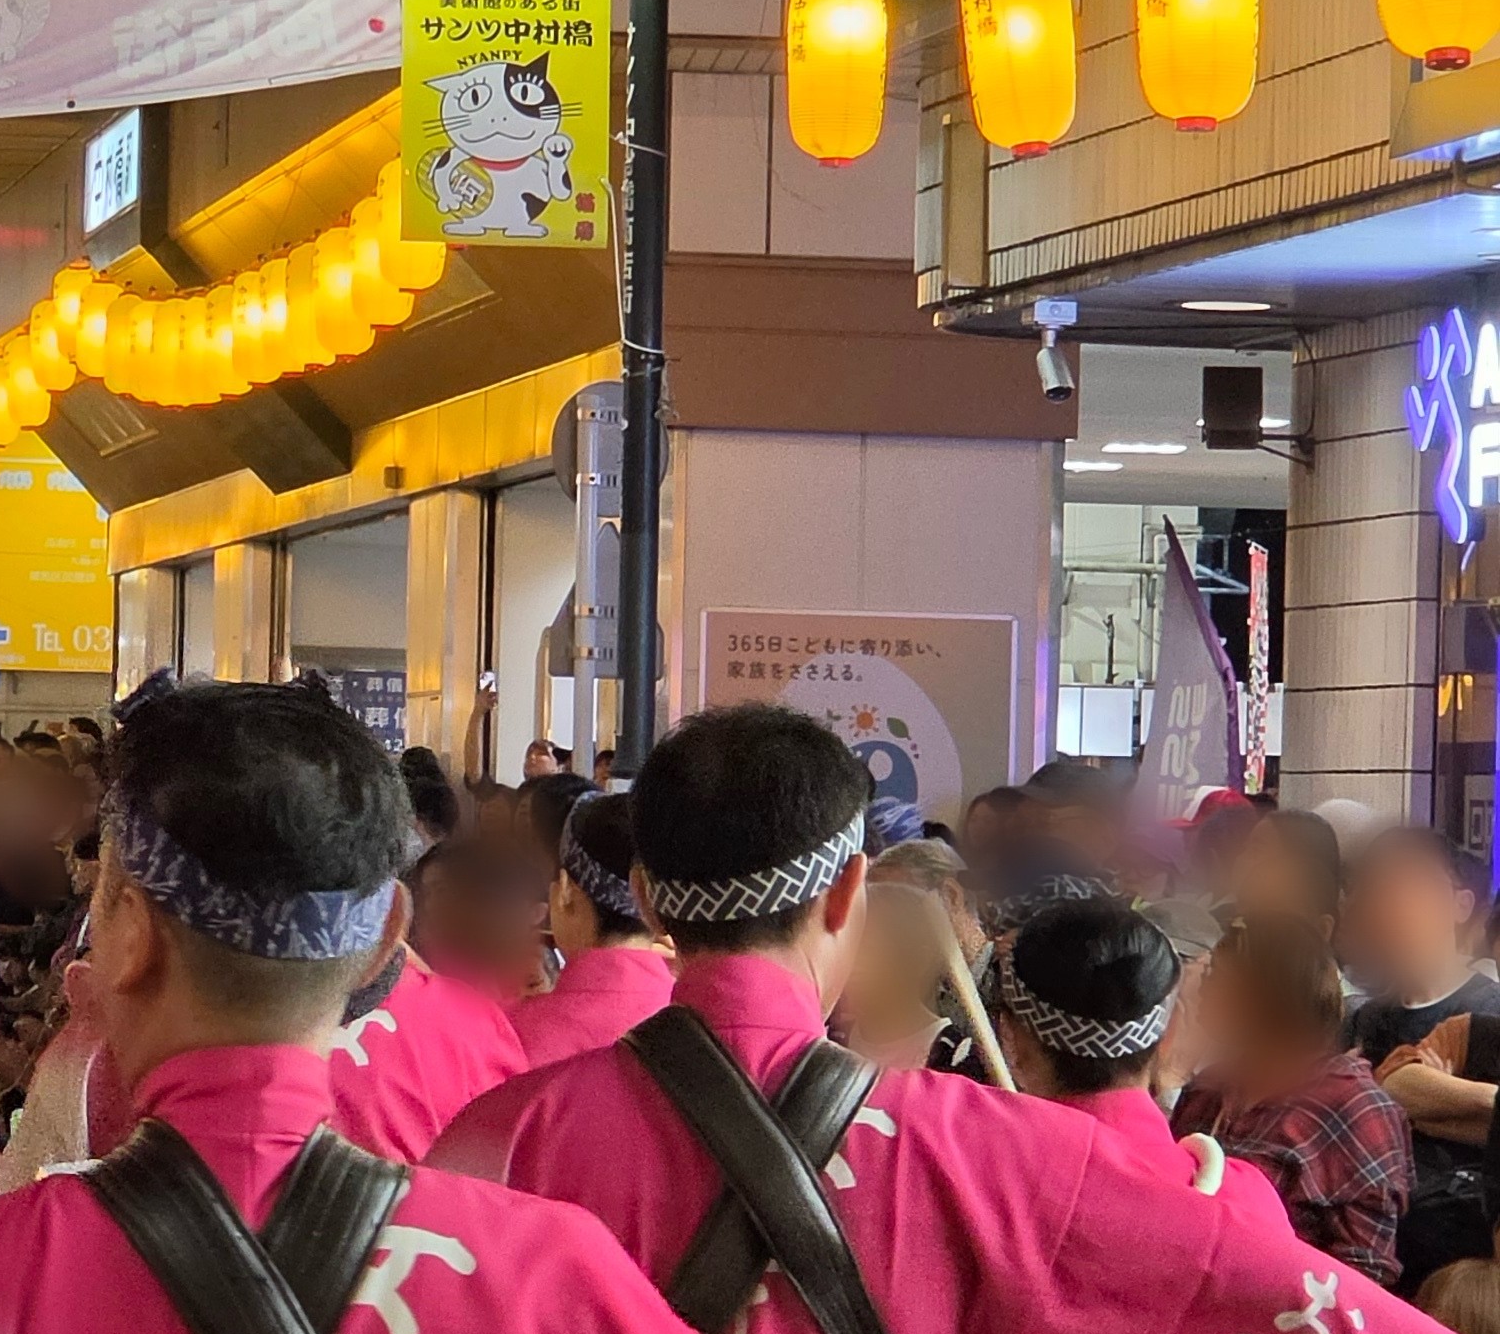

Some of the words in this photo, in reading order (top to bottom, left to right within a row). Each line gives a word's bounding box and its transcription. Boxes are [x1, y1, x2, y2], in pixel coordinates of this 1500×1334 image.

[420, 15, 594, 48] サンツ中村橋
[455, 49, 524, 71] NYANPY
[32, 622, 65, 652] TEL
[72, 625, 112, 652] 03
[726, 634, 942, 658] 365日こどもに寄り添い、
[726, 659, 864, 682] 家族をささえる。
